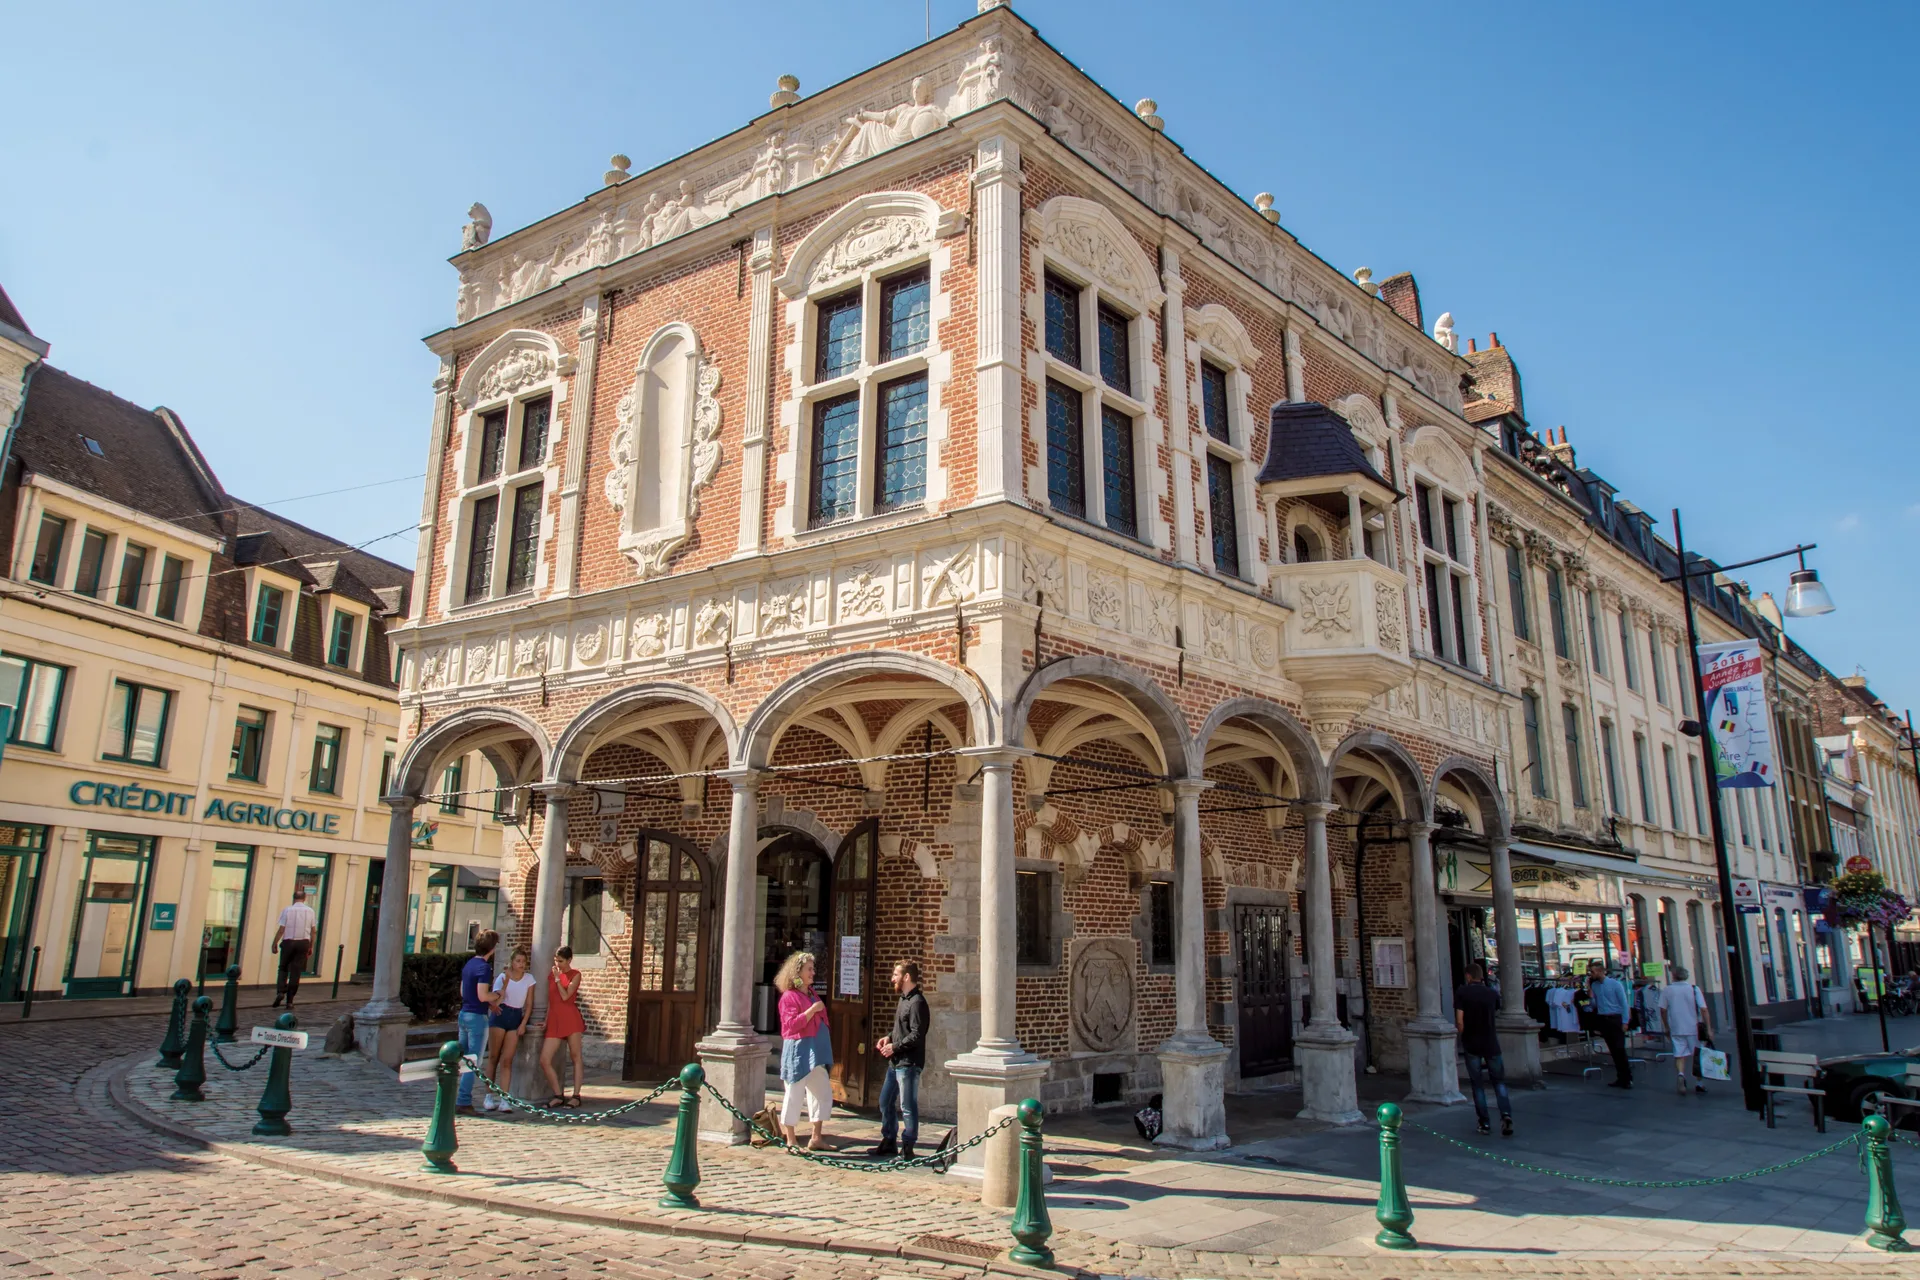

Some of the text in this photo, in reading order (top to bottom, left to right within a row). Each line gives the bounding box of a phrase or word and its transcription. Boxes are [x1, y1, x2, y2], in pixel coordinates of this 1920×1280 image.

[1709, 661, 1754, 682] Année du
[1712, 653, 1745, 671] 2016
[1708, 669, 1753, 690] Jumelage
[1719, 751, 1741, 761] Aire
[69, 781, 341, 835] CRÉDIT AGRICOLE
[264, 1031, 300, 1045] Toutes Directions
